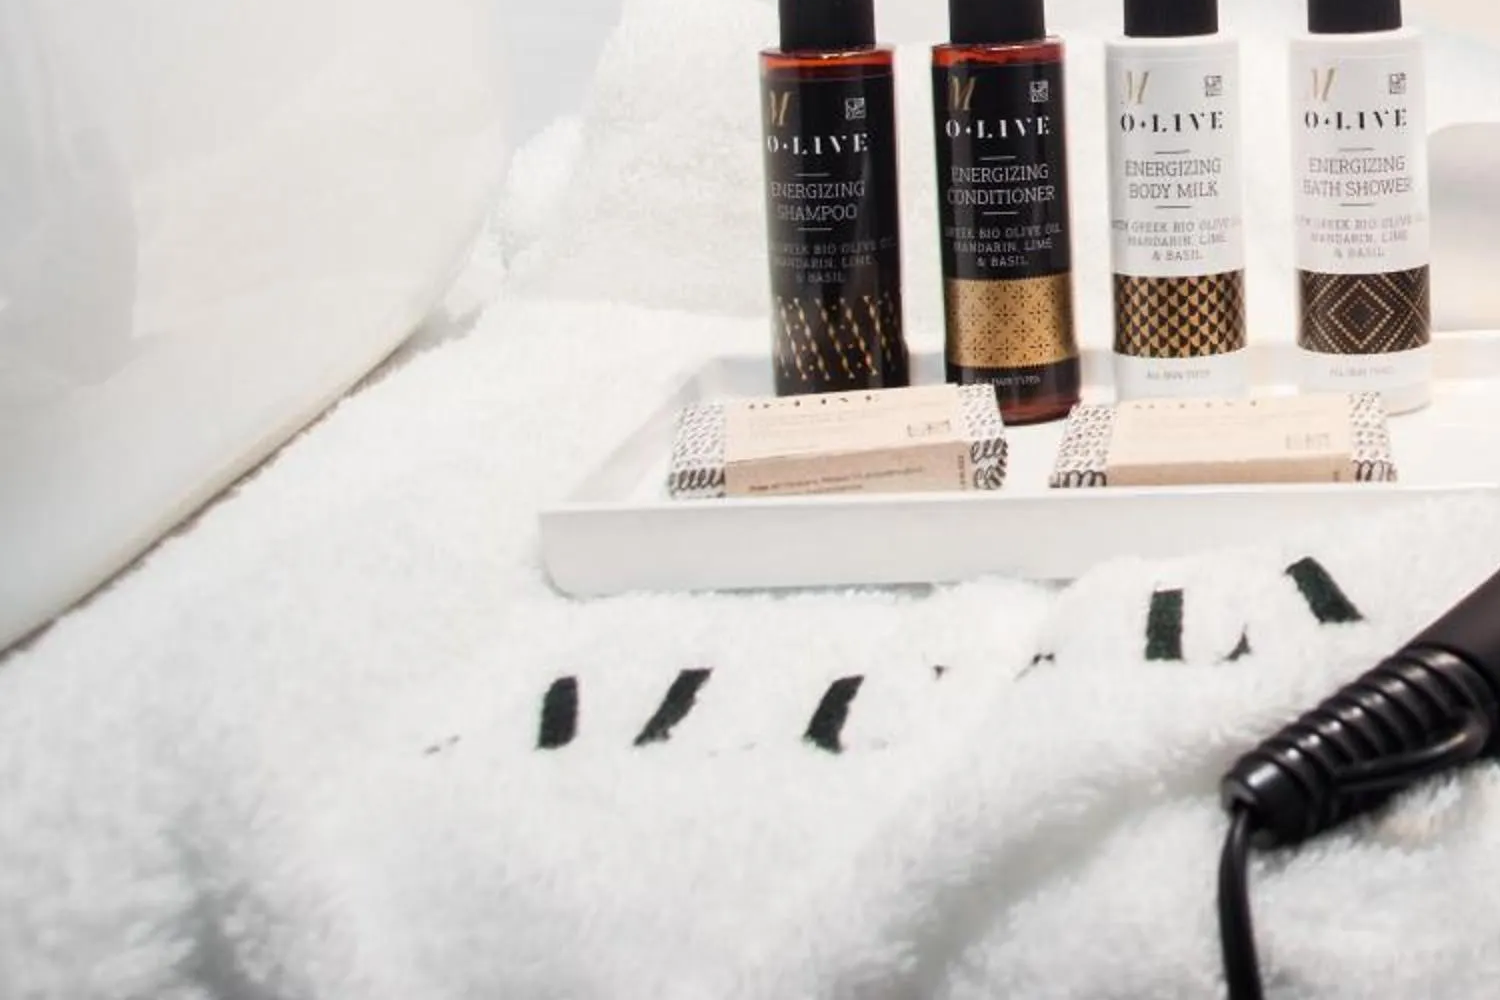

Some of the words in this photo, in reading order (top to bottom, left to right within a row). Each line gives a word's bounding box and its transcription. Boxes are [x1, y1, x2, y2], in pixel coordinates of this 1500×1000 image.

[950, 163, 1049, 183] ENERGIZING
[1124, 158, 1222, 178] ENERGIZING
[1308, 154, 1406, 175] ENERGIZING
[770, 181, 866, 199] ENERGIZING
[946, 185, 1056, 205] CONDITIONER
[1128, 183, 1171, 200] BODY
[1176, 180, 1219, 199] MILK
[1302, 179, 1341, 197] BATH
[1345, 177, 1413, 197] SHOWER
[776, 204, 858, 221] SHAMPOO
[990, 255, 1029, 267] BASIL
[1165, 249, 1204, 262] BASIL
